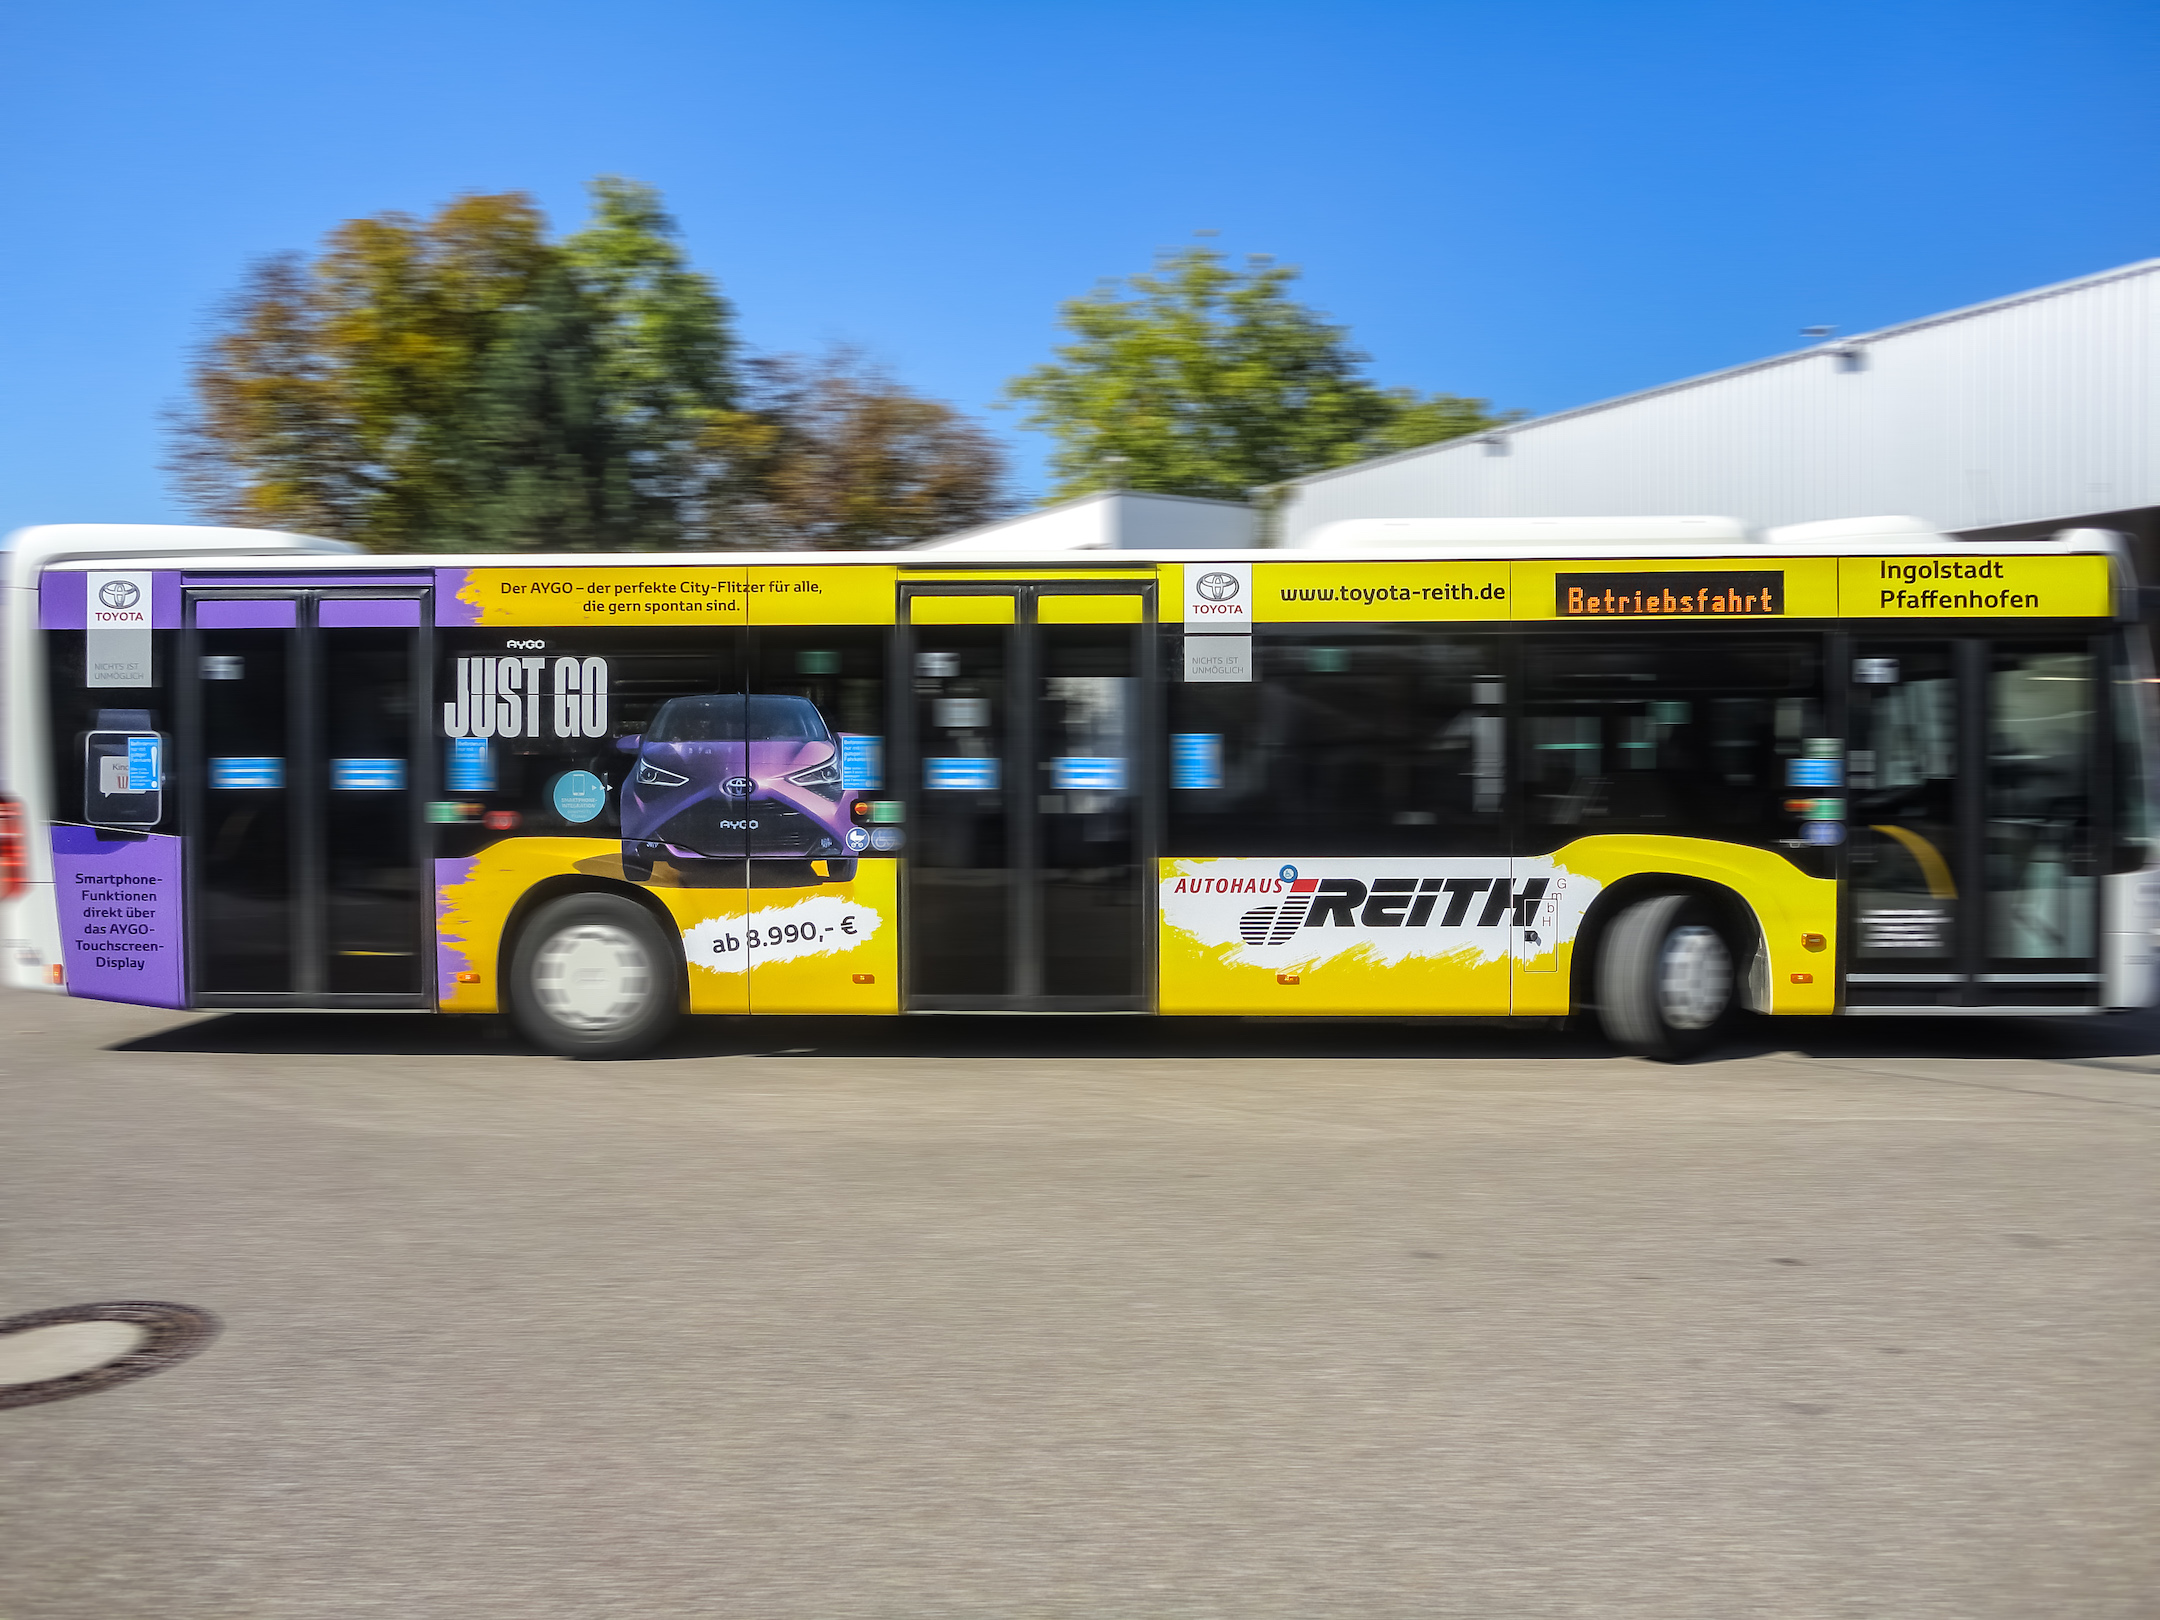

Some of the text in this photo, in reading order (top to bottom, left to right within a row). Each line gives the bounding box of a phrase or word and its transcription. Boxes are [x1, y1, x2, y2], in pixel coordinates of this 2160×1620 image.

[1880, 560, 2003, 583] Ingolstadt
[501, 582, 527, 594] Der
[530, 582, 573, 594] AYGO
[587, 582, 611, 594] der
[614, 581, 676, 596] perfekte
[680, 581, 765, 596] City-Flitzer
[769, 580, 790, 593] für
[793, 580, 822, 595] alle,
[1281, 583, 1505, 605] www.toyota-reith.de
[1568, 586, 1773, 614] Betriebsfahrt
[1880, 588, 2038, 609] Pfaffenhofen
[583, 599, 740, 615] die gern spontan sind.
[1192, 604, 1243, 614] TOYOTA
[95, 612, 144, 621] TOYOTA
[506, 639, 545, 649] AYGO
[94, 663, 124, 671] NICHTS
[1192, 657, 1239, 665] NICHTS IST
[94, 671, 144, 680] UNMÖGLICH
[1192, 665, 1244, 674] UNMÖGLICH
[444, 656, 608, 738] JUST GO
[719, 820, 759, 830] AYGO
[75, 873, 163, 887] Smartphone-
[82, 890, 157, 902] Funktionen
[1174, 877, 1551, 928] AUTOHAUS REITH
[83, 907, 156, 918] direkt über
[84, 923, 155, 935] das AYGO-
[712, 915, 857, 954] ab 8.990,- €
[75, 940, 164, 951] Touchscreen-
[96, 956, 145, 971] Display
